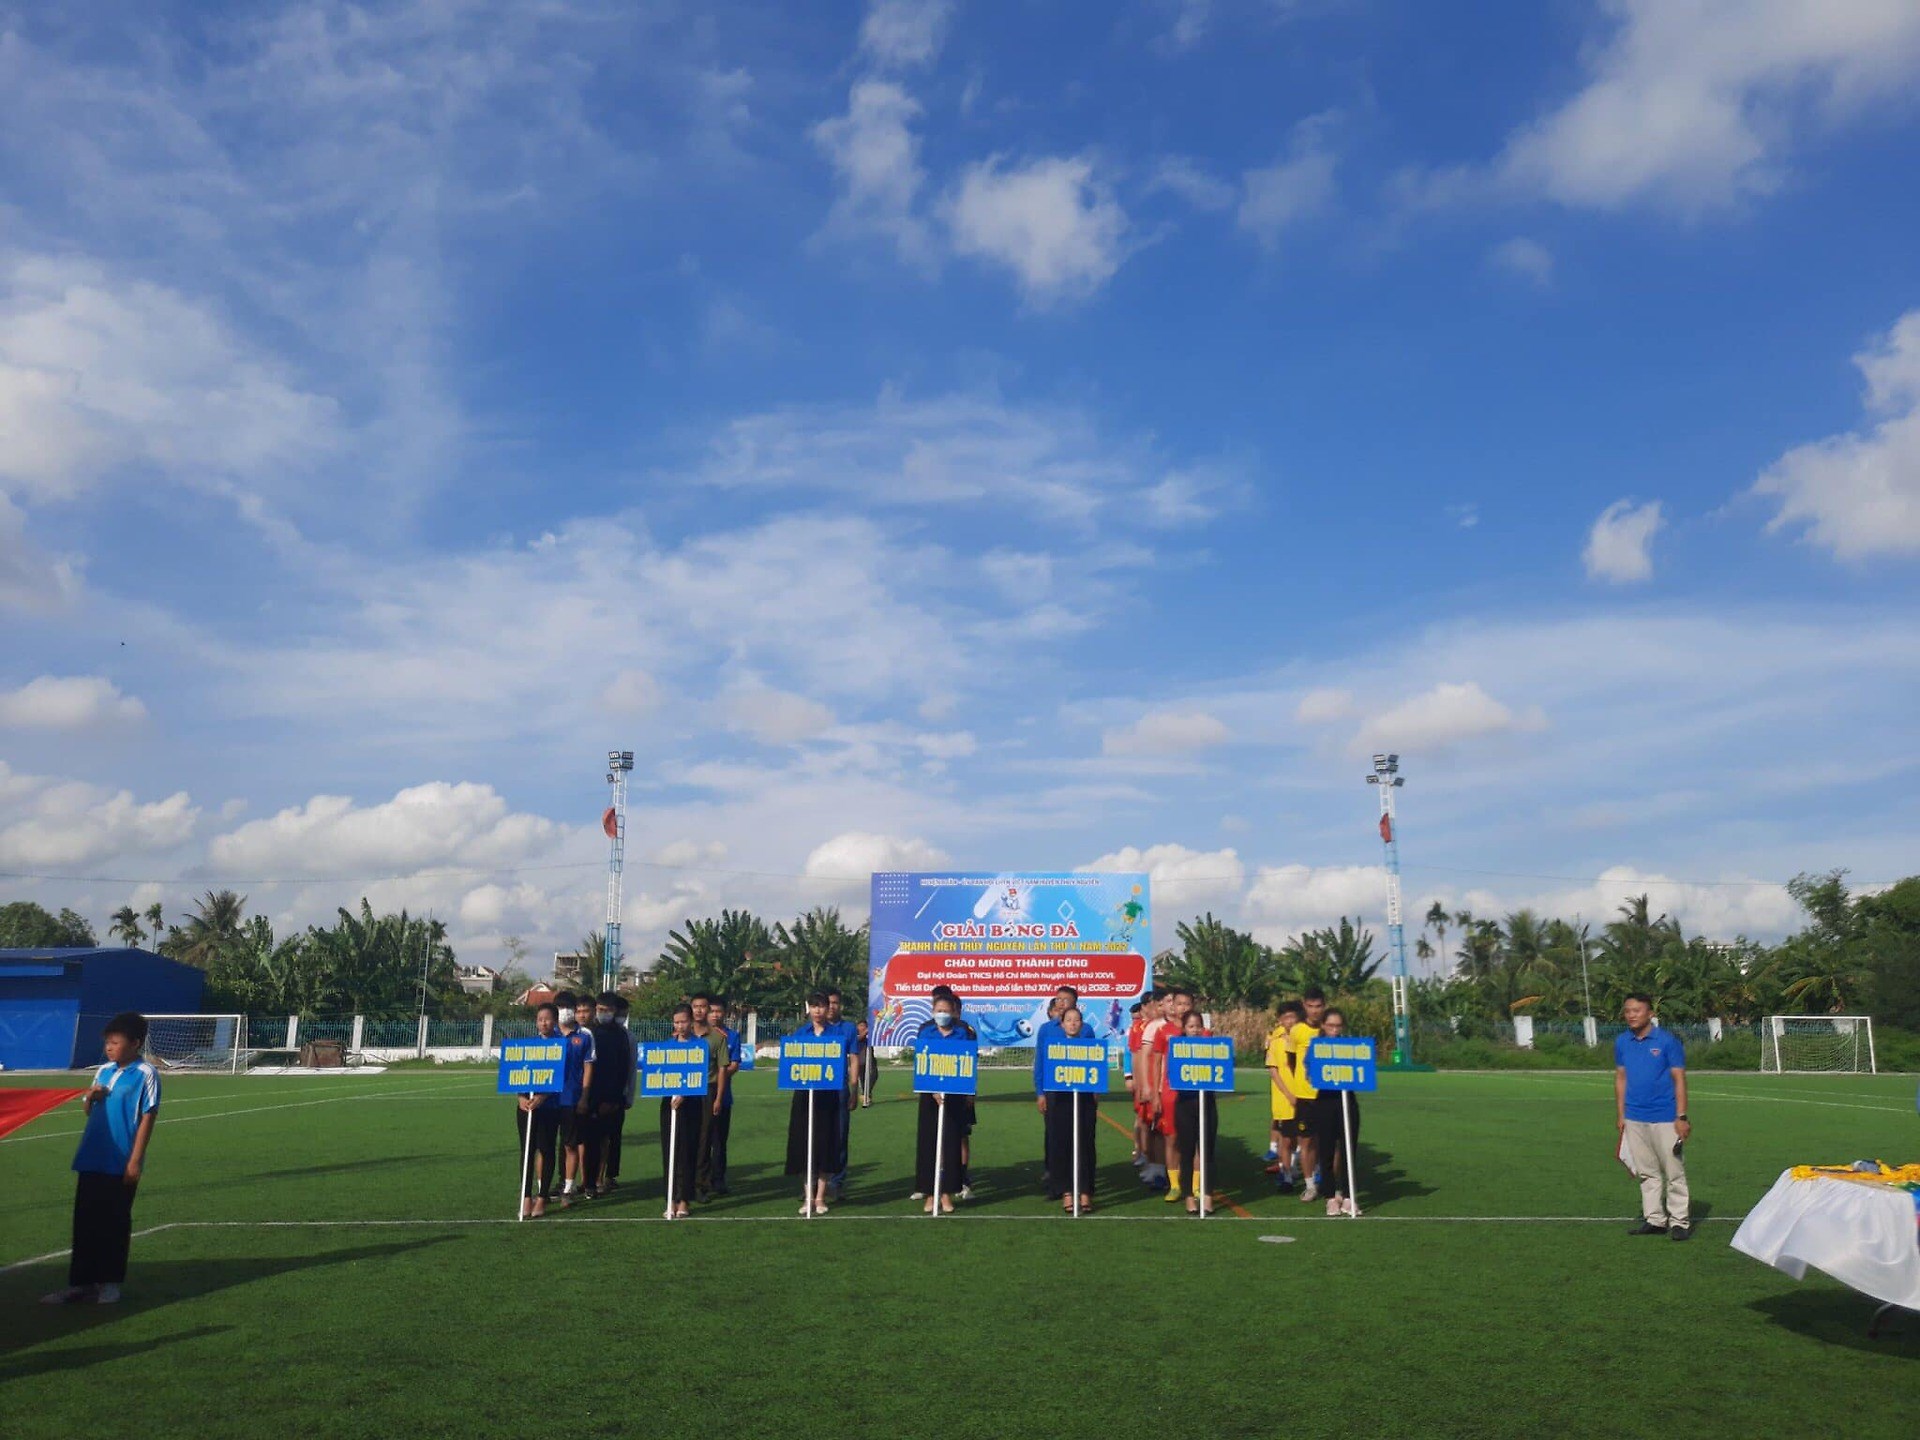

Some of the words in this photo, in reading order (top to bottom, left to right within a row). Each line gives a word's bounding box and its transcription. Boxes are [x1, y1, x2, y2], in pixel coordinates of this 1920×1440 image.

[943, 919, 986, 938] GIẢI
[1050, 920, 1080, 938] ĐÁ
[944, 957, 975, 968] CHÀO
[1015, 957, 1055, 968] THÀNH
[1057, 957, 1088, 968] CÔNG
[969, 971, 992, 979] TNCS
[1020, 971, 1040, 979] Minh
[916, 1045, 929, 1075] TỔ
[929, 1054, 958, 1081] TRỌNG
[959, 1051, 973, 1078] TÀI
[532, 1069, 554, 1085] THPT
[790, 1064, 822, 1085] CỤM
[825, 1065, 835, 1081] 4
[1054, 1066, 1086, 1086] CỤM
[1088, 1067, 1098, 1084] 3
[1180, 1064, 1212, 1086] CỤM
[1214, 1066, 1224, 1082] 2
[1322, 1065, 1353, 1085] CỤM
[1357, 1066, 1364, 1083] 1
